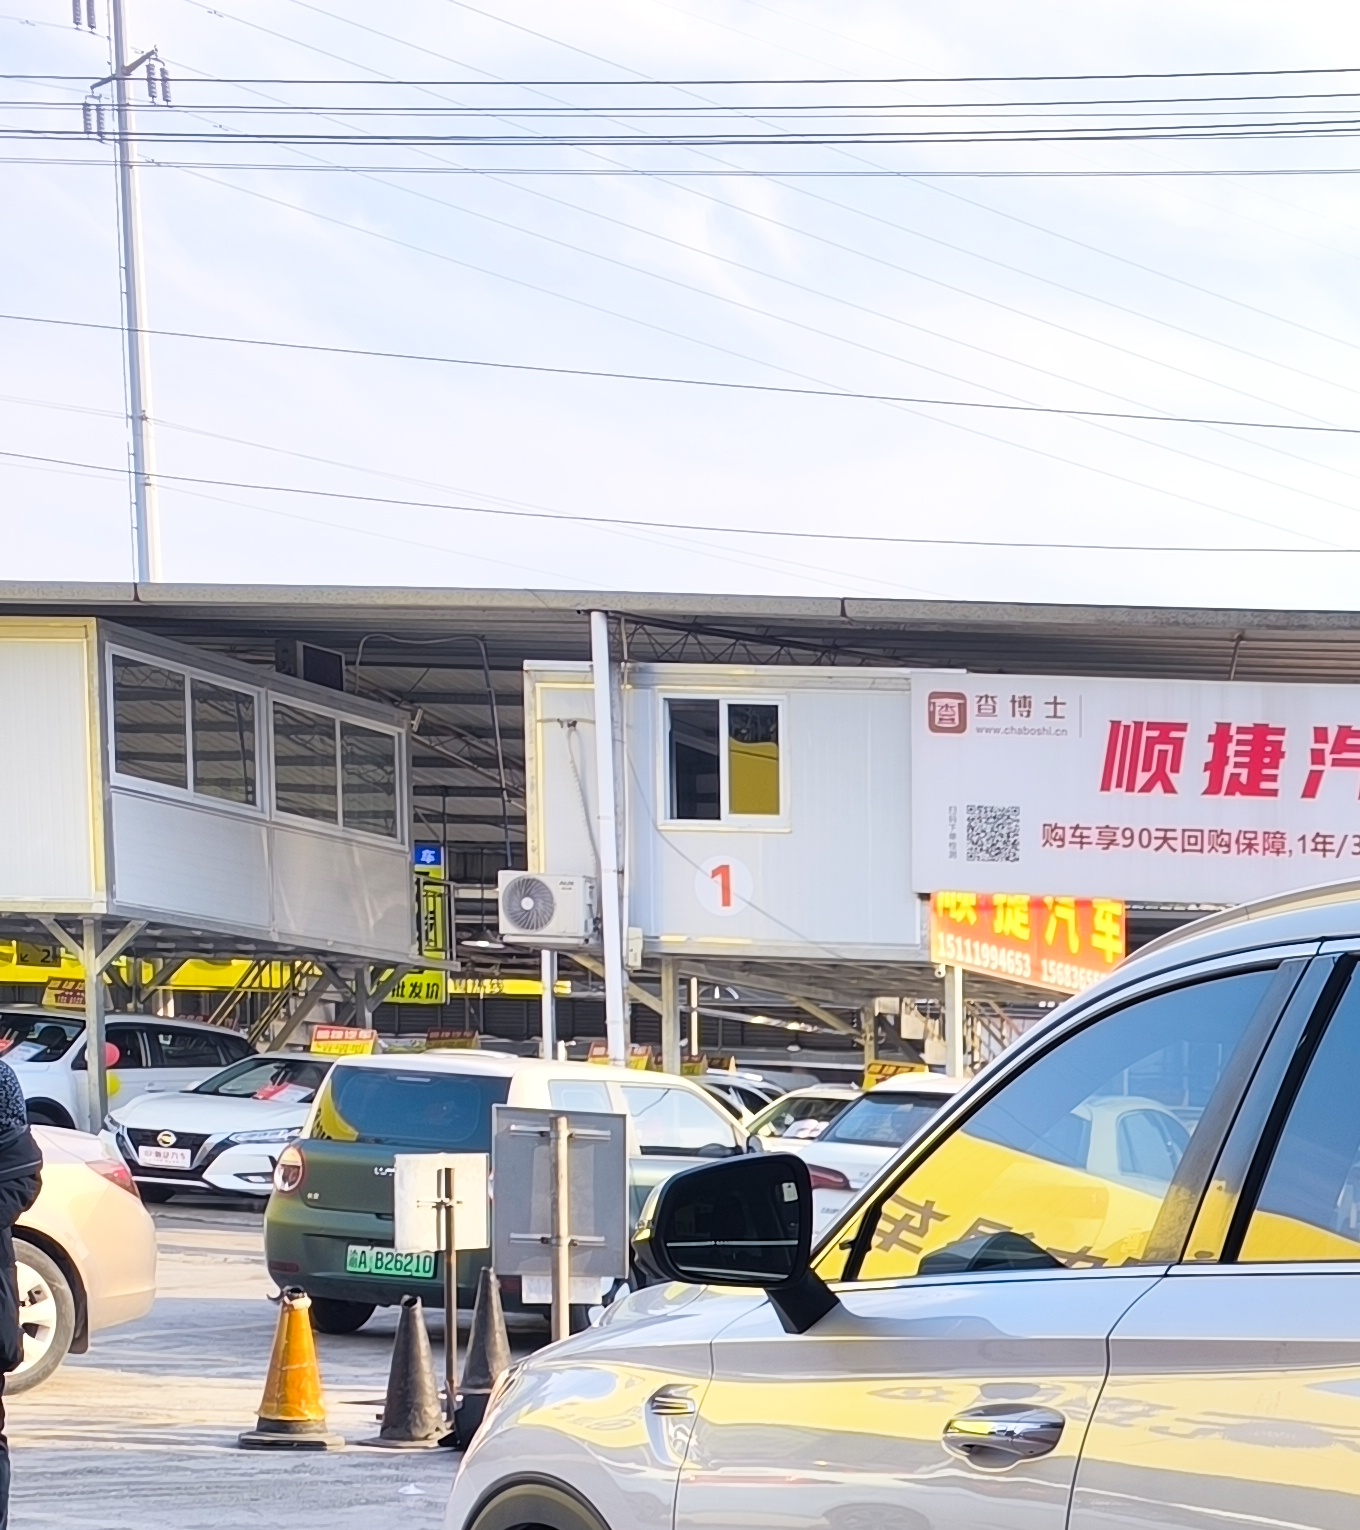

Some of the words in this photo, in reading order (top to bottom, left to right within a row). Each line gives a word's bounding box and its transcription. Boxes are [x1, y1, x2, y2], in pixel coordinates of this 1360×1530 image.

[975, 694, 1067, 719] 查博士
[975, 725, 1069, 737] www.chaboshi.cn
[711, 864, 731, 907] 1
[374, 1251, 433, 1274] B26210
